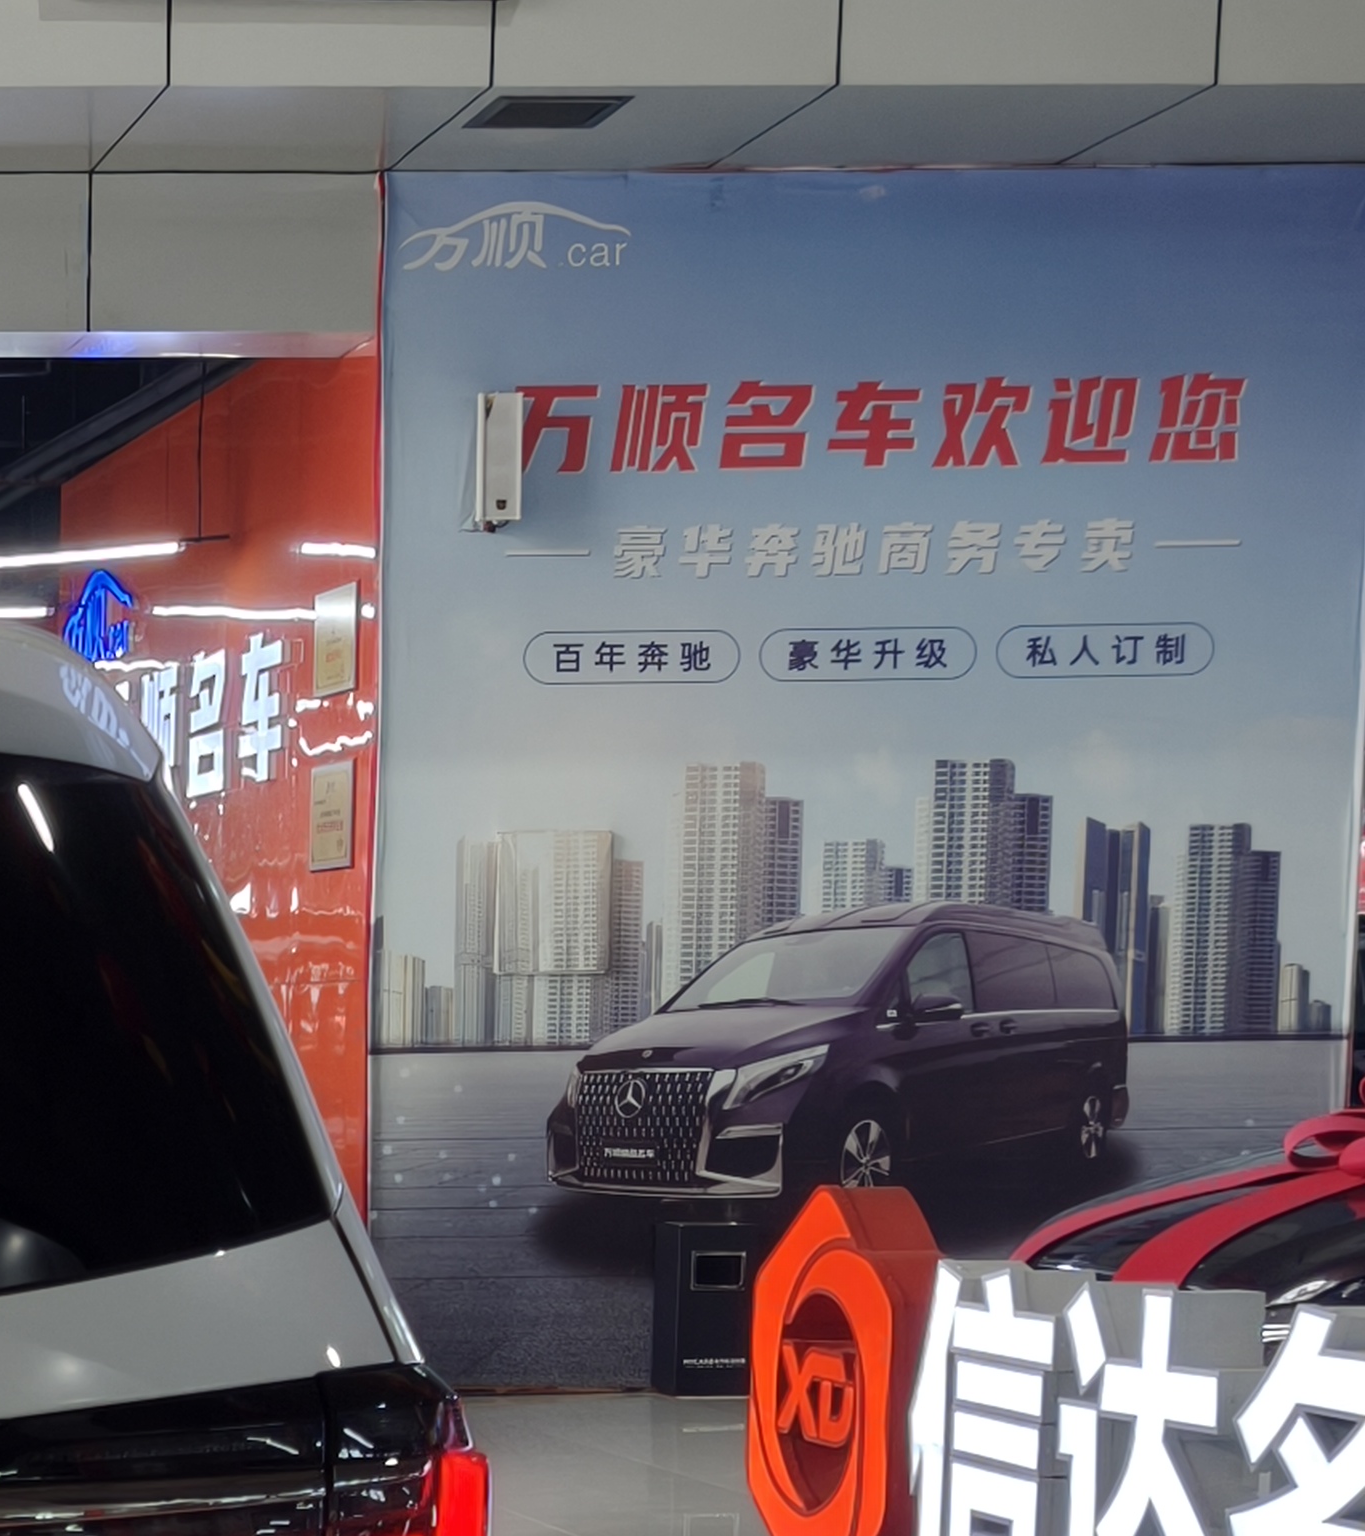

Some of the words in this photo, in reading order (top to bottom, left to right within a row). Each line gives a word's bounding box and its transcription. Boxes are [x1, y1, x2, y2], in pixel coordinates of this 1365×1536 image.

[514, 373, 1249, 473] 万顺名车欢迎您
[613, 518, 1137, 580] 豪华奔驰商务专卖
[553, 640, 712, 674] 百年奔驰
[788, 636, 950, 671] 豪华升级
[1026, 634, 1189, 667] 私人订制
[115, 632, 283, 797] 顺名车
